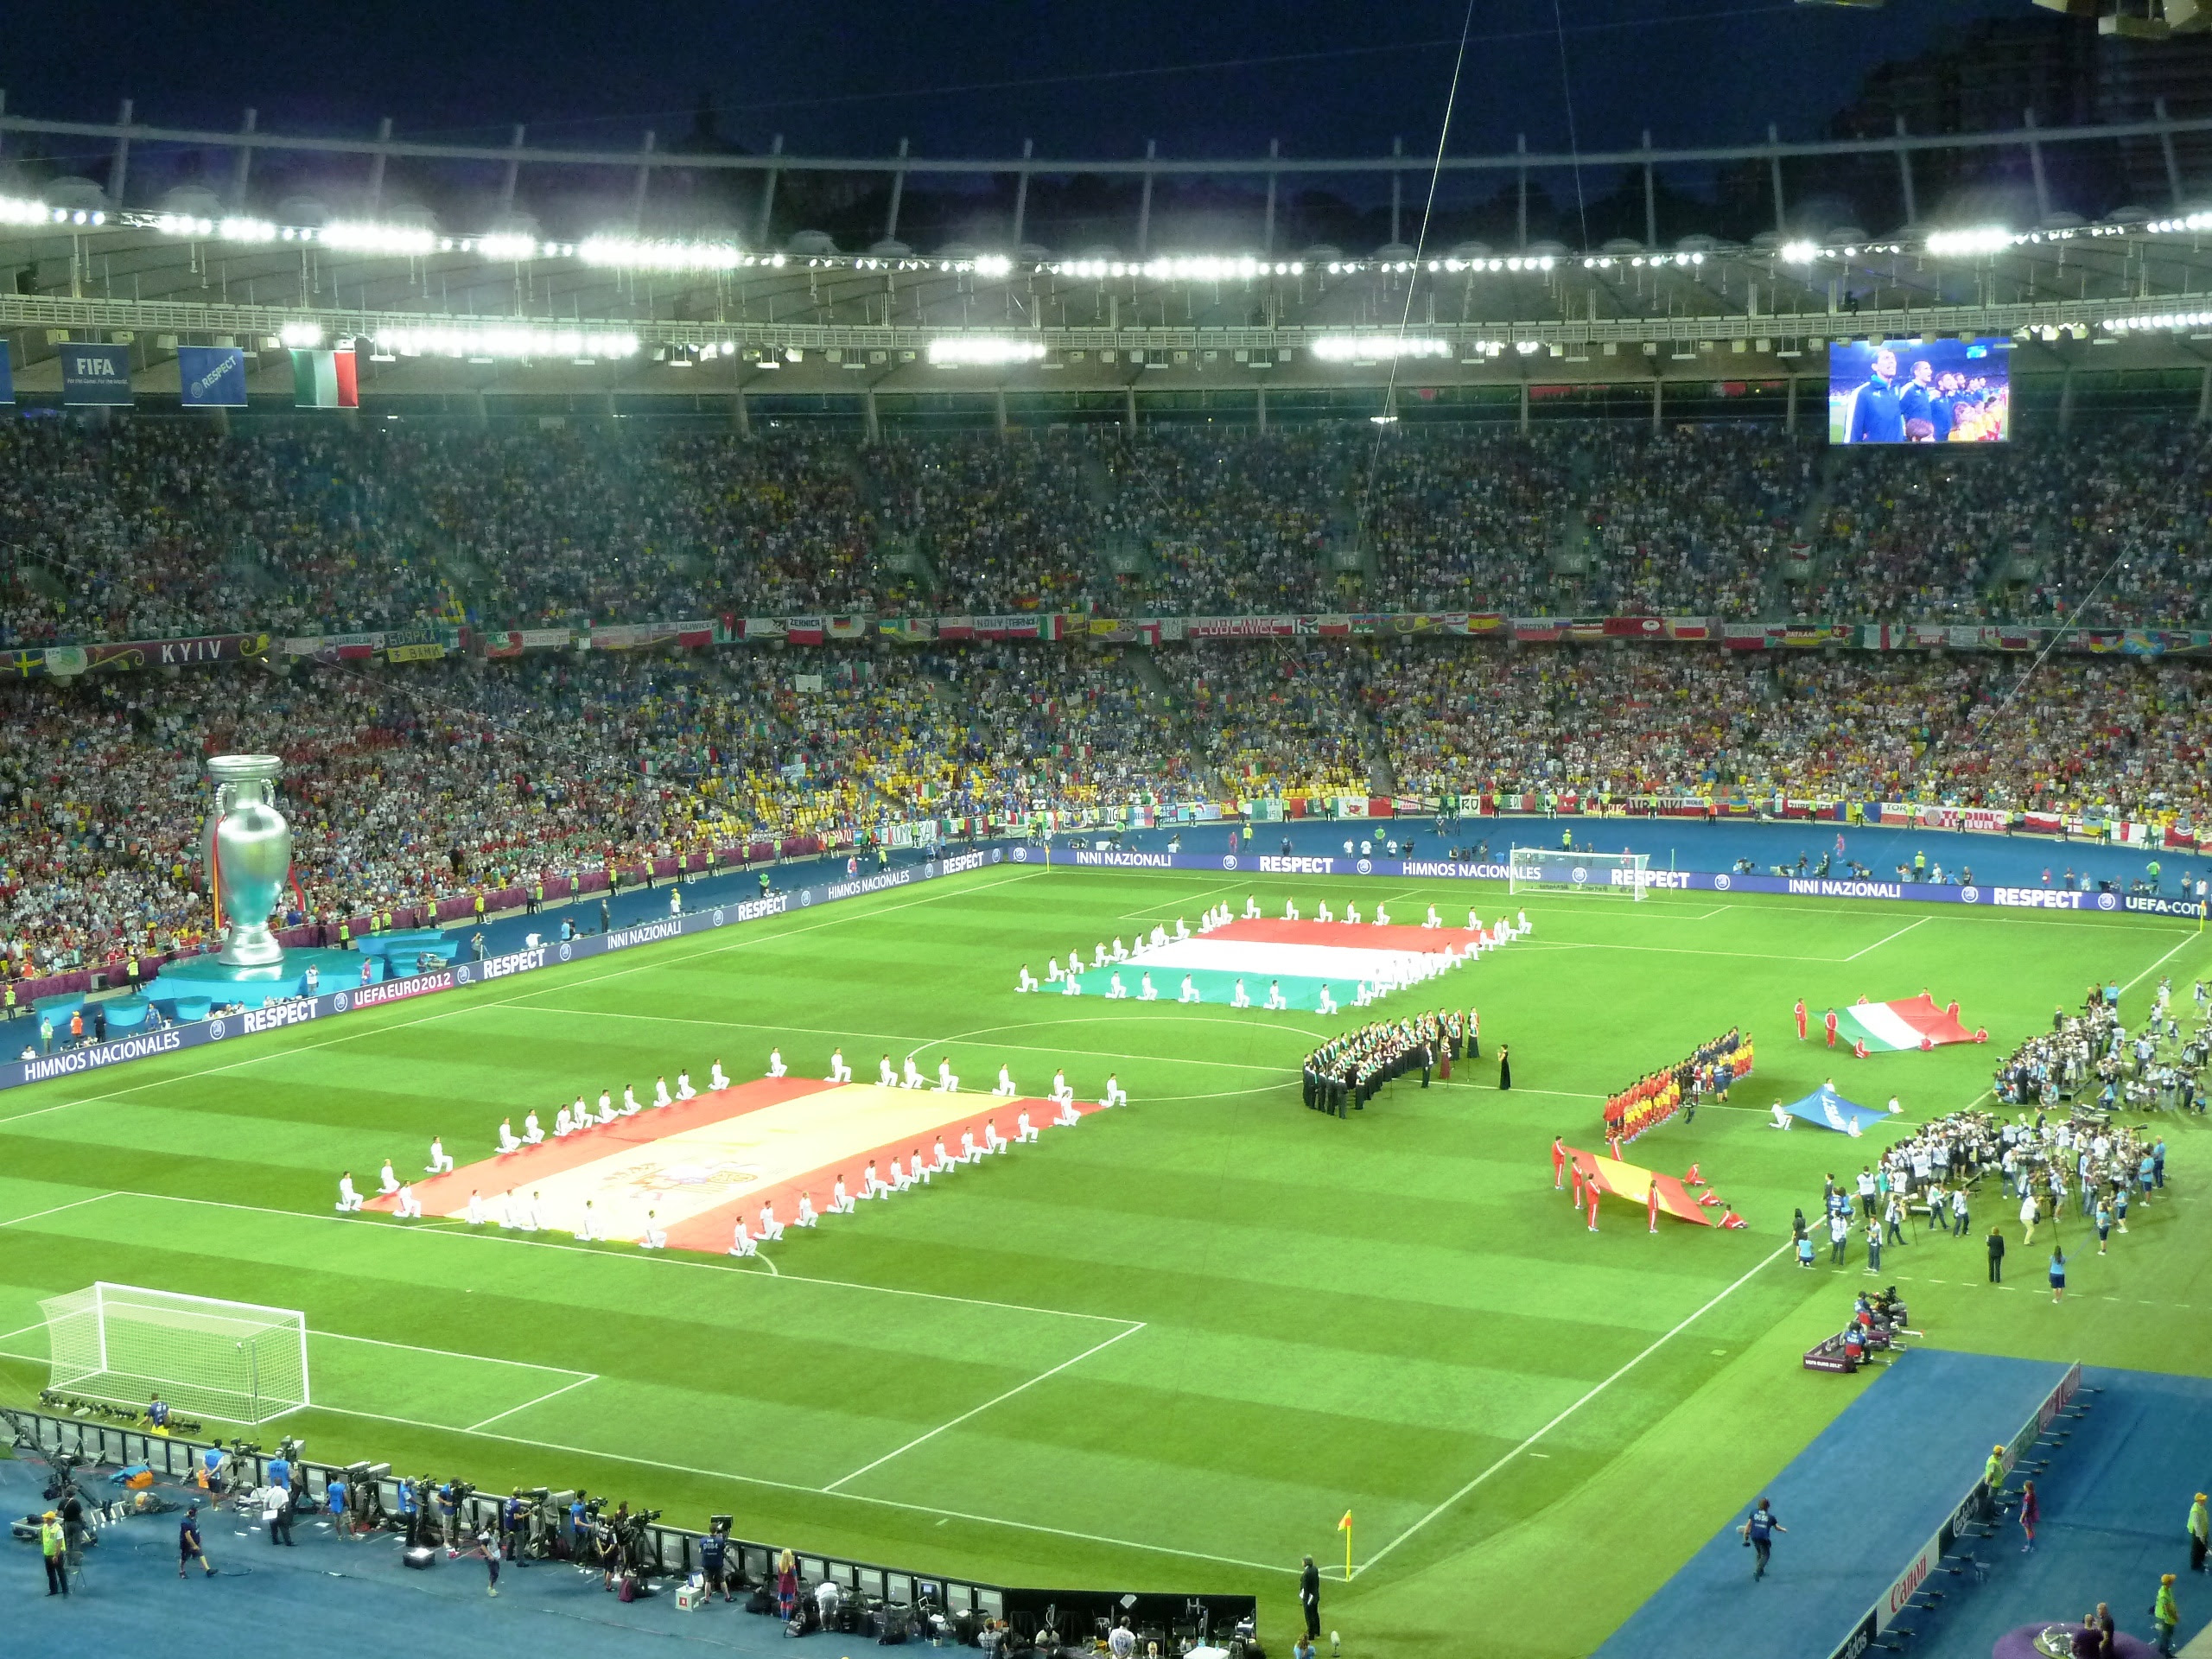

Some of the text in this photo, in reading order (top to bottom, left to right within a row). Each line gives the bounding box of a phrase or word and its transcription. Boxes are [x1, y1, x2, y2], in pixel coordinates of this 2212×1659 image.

[76, 358, 115, 375] FIFA
[201, 354, 238, 389] RESPECT
[162, 640, 221, 664] KYIV
[1631, 798, 1682, 816] WRNKI
[1886, 804, 1922, 813] TORN
[943, 851, 984, 875] RESPECT
[1076, 851, 1172, 867] INNI NAZIONALI
[1259, 855, 1334, 874] RESPECT
[1402, 862, 1541, 880] HIMNOS NACIONALES
[828, 869, 910, 899] HIMNOS NACIONALES
[1611, 868, 1690, 888] RESPECT
[1789, 879, 1901, 898] INNI NAZIONALI
[738, 894, 787, 922] RESPECT
[1993, 887, 2082, 909] RESPECT
[607, 920, 682, 950] INNI NAZIONALI
[483, 948, 545, 980] RESPECT
[354, 972, 451, 1007] UEFA EURO 2012
[244, 998, 318, 1033] RESPECT
[24, 1031, 181, 1081] HIMNOS NACIONALES
[1890, 1554, 1927, 1613] Canon
